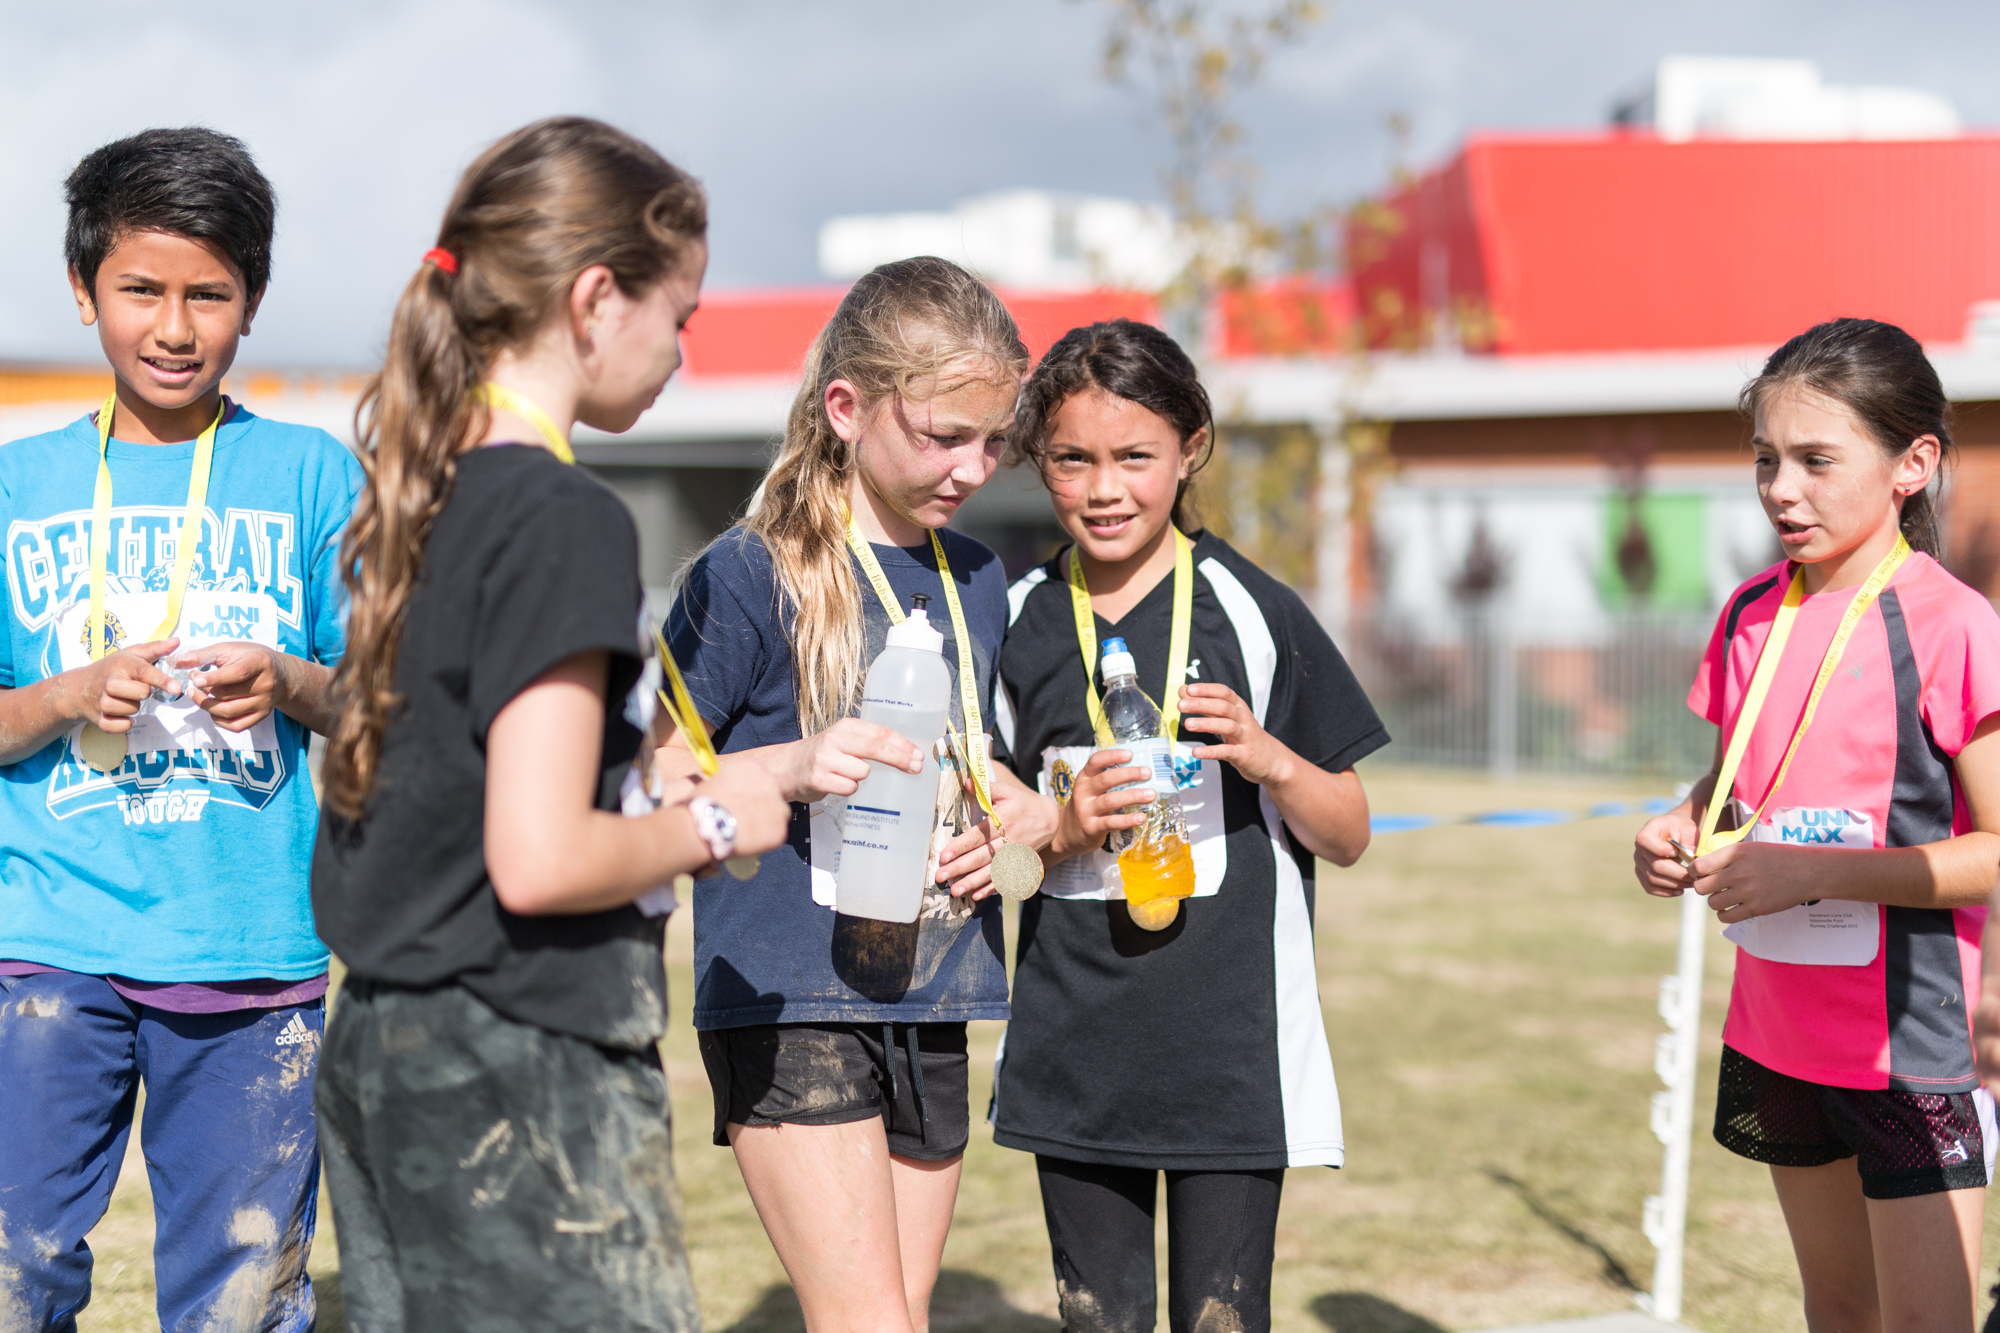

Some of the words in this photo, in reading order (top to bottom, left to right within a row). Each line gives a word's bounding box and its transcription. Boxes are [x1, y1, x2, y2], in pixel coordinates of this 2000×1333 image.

[856, 546, 874, 571] Club
[871, 574, 903, 625] Hobsonvi
[1857, 576, 1882, 604] Lions
[214, 605, 260, 623] UNI
[1081, 602, 1092, 628] Point
[1842, 607, 1859, 632] Club
[189, 621, 254, 640] MAX
[1811, 635, 1845, 702] Hobsonville
[964, 674, 975, 700] Club
[970, 705, 981, 737] Lions
[1175, 756, 1202, 771] NI
[860, 822, 880, 831] FITNESS
[871, 815, 900, 825] INSTITUTE
[1801, 810, 1850, 826] UNI
[1781, 825, 1845, 843] MAX
[275, 1031, 314, 1046] adidas
